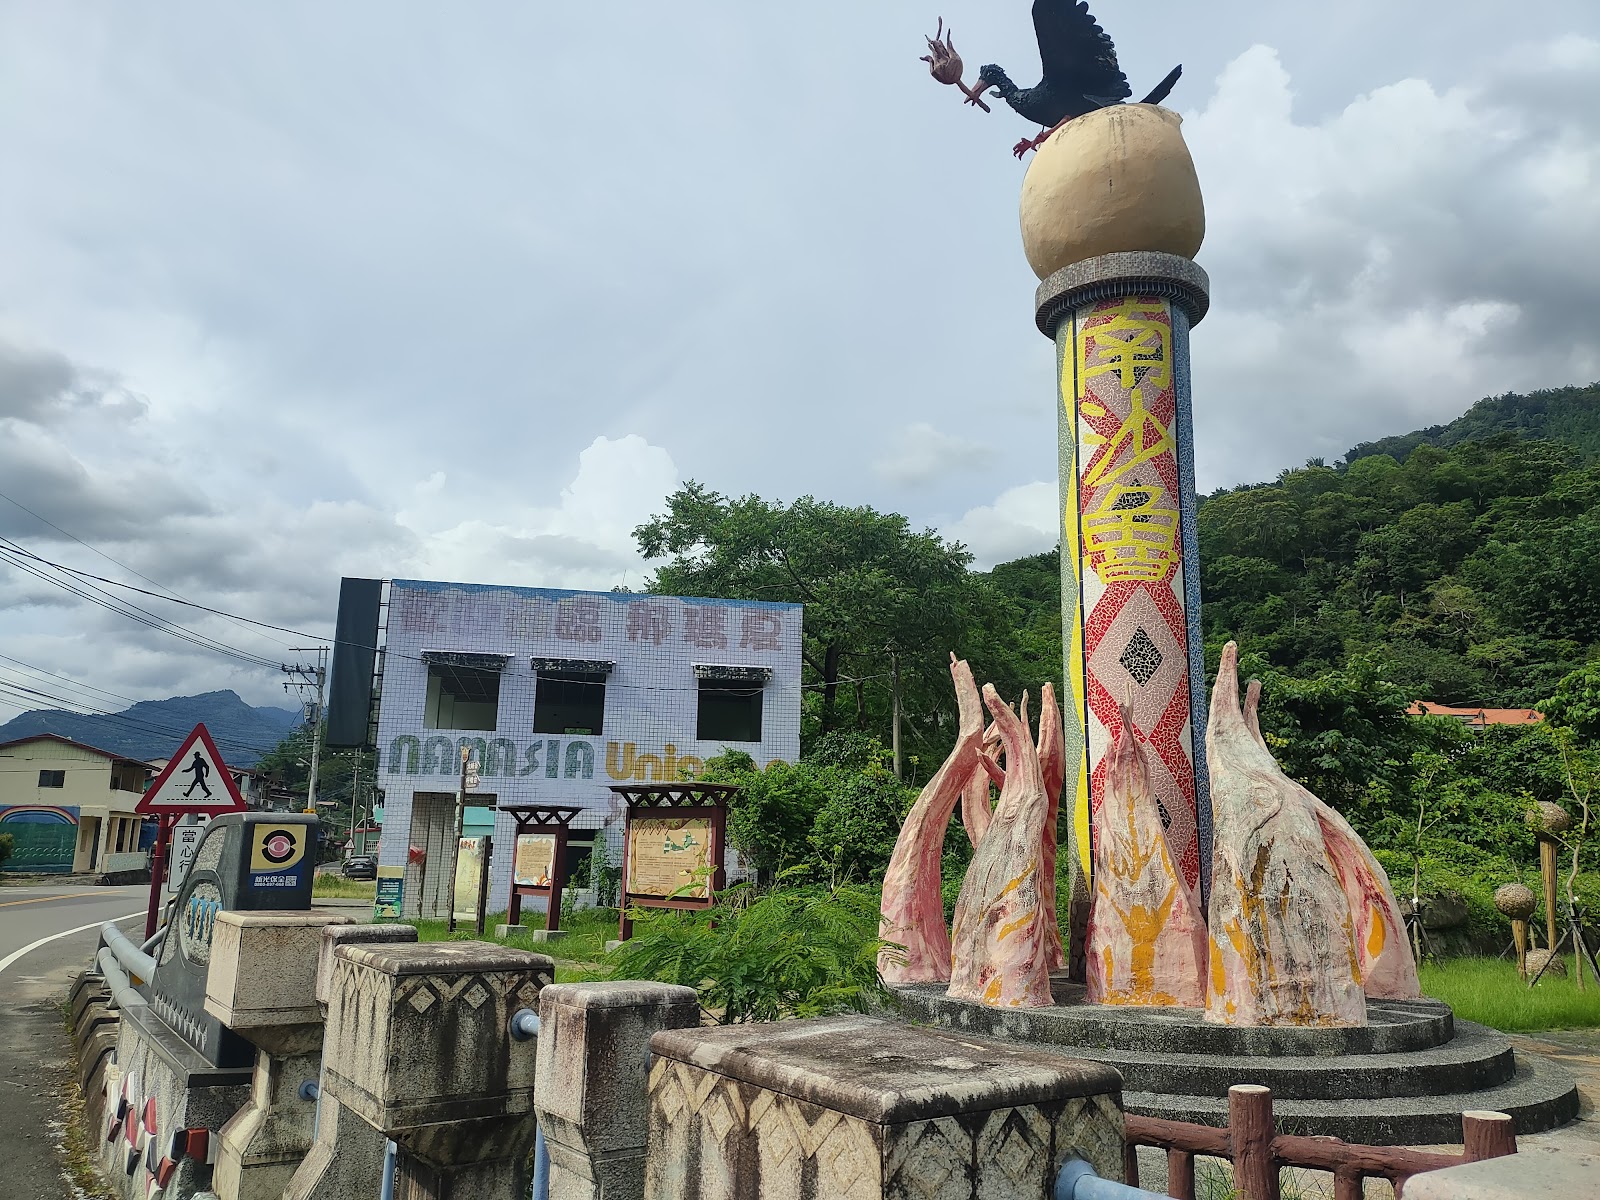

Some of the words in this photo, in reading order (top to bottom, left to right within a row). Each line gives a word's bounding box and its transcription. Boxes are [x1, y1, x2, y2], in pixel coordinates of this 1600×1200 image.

[1077, 297, 1179, 585] 南沙魯
[388, 735, 594, 779] NAMASIA
[177, 829, 196, 887] 當心行
